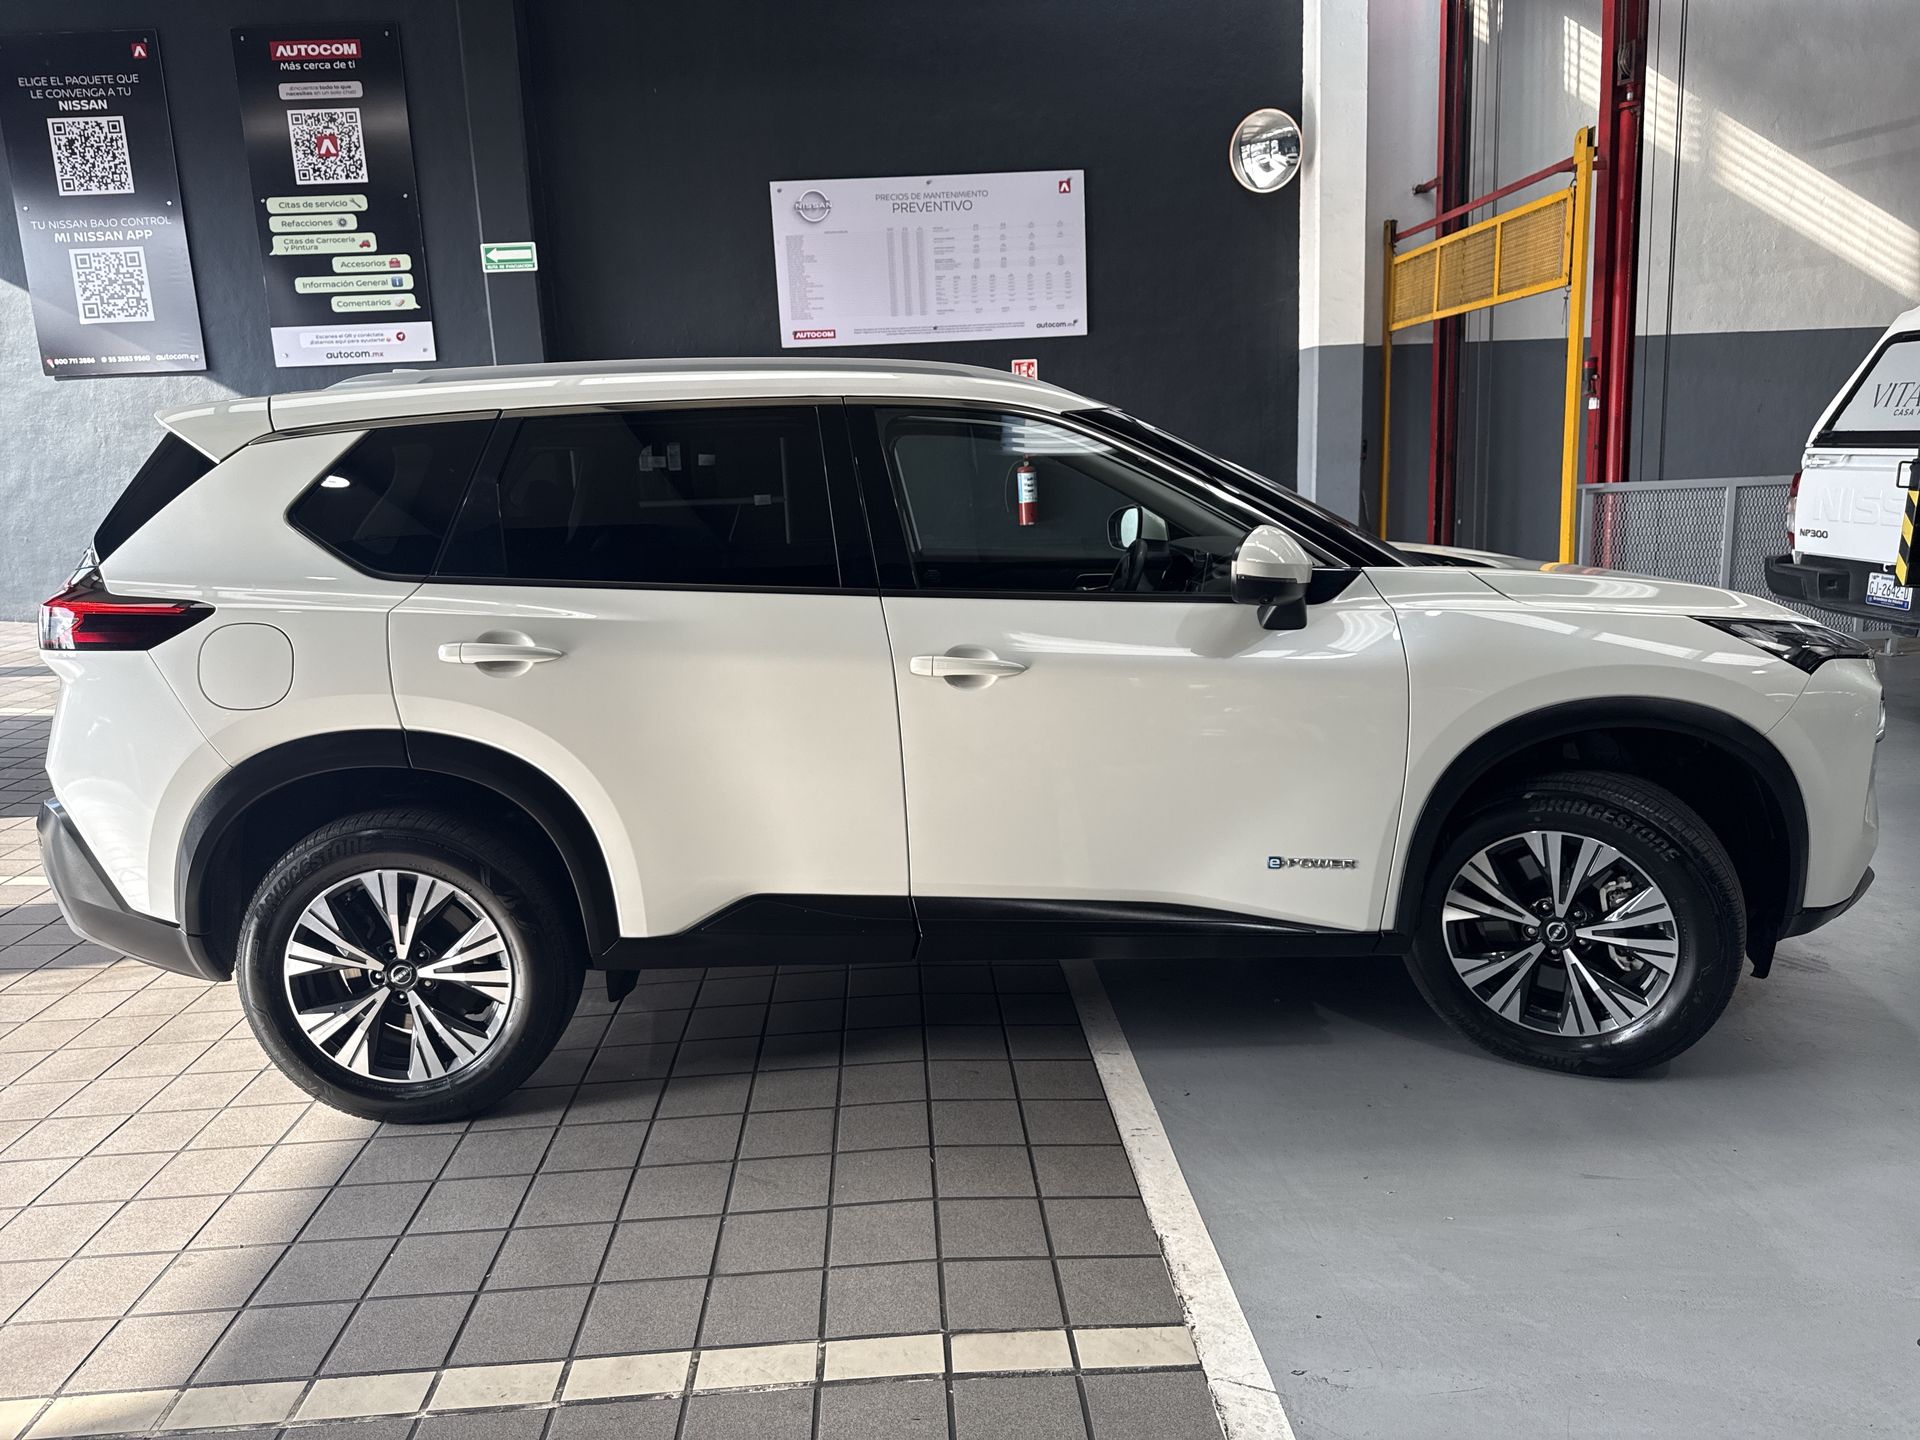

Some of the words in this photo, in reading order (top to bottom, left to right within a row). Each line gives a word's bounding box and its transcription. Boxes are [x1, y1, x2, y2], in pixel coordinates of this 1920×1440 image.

[276, 43, 358, 57] AUTOCOM
[280, 61, 301, 71] Más
[303, 62, 331, 70] cerca
[333, 60, 346, 69] de
[348, 60, 356, 69] ti
[18, 76, 48, 87] ELIGE
[50, 76, 63, 86] EL
[65, 75, 114, 86] PAQUETE
[116, 73, 139, 83] QUE
[30, 89, 43, 99] LE
[45, 88, 105, 99] CONVENGA
[108, 88, 115, 97] A
[116, 87, 132, 96] TU
[58, 99, 108, 111] NISSAN
[875, 193, 909, 201] PRECIOS
[923, 190, 989, 200] MANTENIMIENTO
[278, 201, 301, 209] Citas
[315, 200, 348, 208] servicio
[794, 200, 832, 211] NISSAN
[892, 199, 973, 213] PREVENTIVO
[30, 221, 46, 230] TU
[48, 219, 87, 229] NISSAN
[90, 218, 118, 228] BAJO
[120, 216, 172, 227] CONTROL
[281, 220, 333, 228] Refacciones
[54, 232, 71, 243] MI
[73, 230, 123, 243] NISSAN
[126, 229, 153, 240] APP
[316, 236, 356, 244] Carrocería
[340, 260, 387, 268] Accesorios
[302, 279, 355, 289] Información
[355, 279, 389, 287] General
[336, 299, 391, 308] Comentarios
[795, 331, 835, 339] AUTOCOM
[326, 350, 384, 359] autocom.mx
[1893, 408, 1915, 416] CASA
[1799, 528, 1829, 539] NP300
